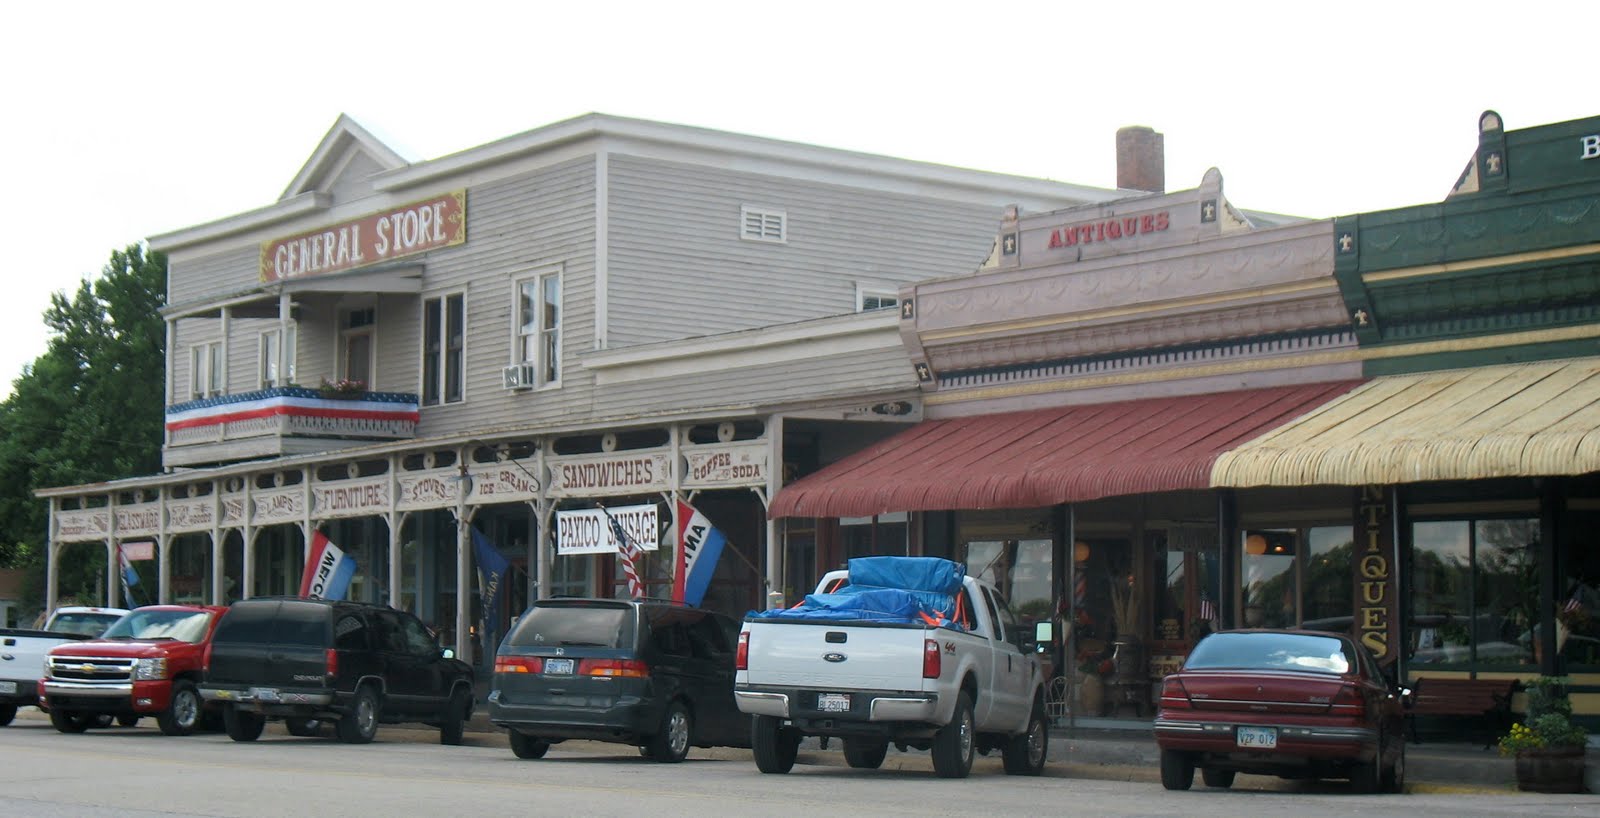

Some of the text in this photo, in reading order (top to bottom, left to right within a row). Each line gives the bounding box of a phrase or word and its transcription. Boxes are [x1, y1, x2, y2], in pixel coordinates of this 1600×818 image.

[274, 201, 447, 279] GENERAL STORE
[1048, 211, 1170, 248] ANTIQUES
[562, 458, 653, 489] SANDWICHES
[693, 452, 731, 481] COFFEE
[732, 464, 761, 479] SODA
[412, 478, 446, 500] STOVES
[479, 470, 529, 495] ICE CREAM
[266, 494, 293, 515] LAMPS
[323, 484, 381, 510] FURNITURE
[118, 511, 159, 531] GLASSWARE
[559, 514, 601, 548] PAXICO
